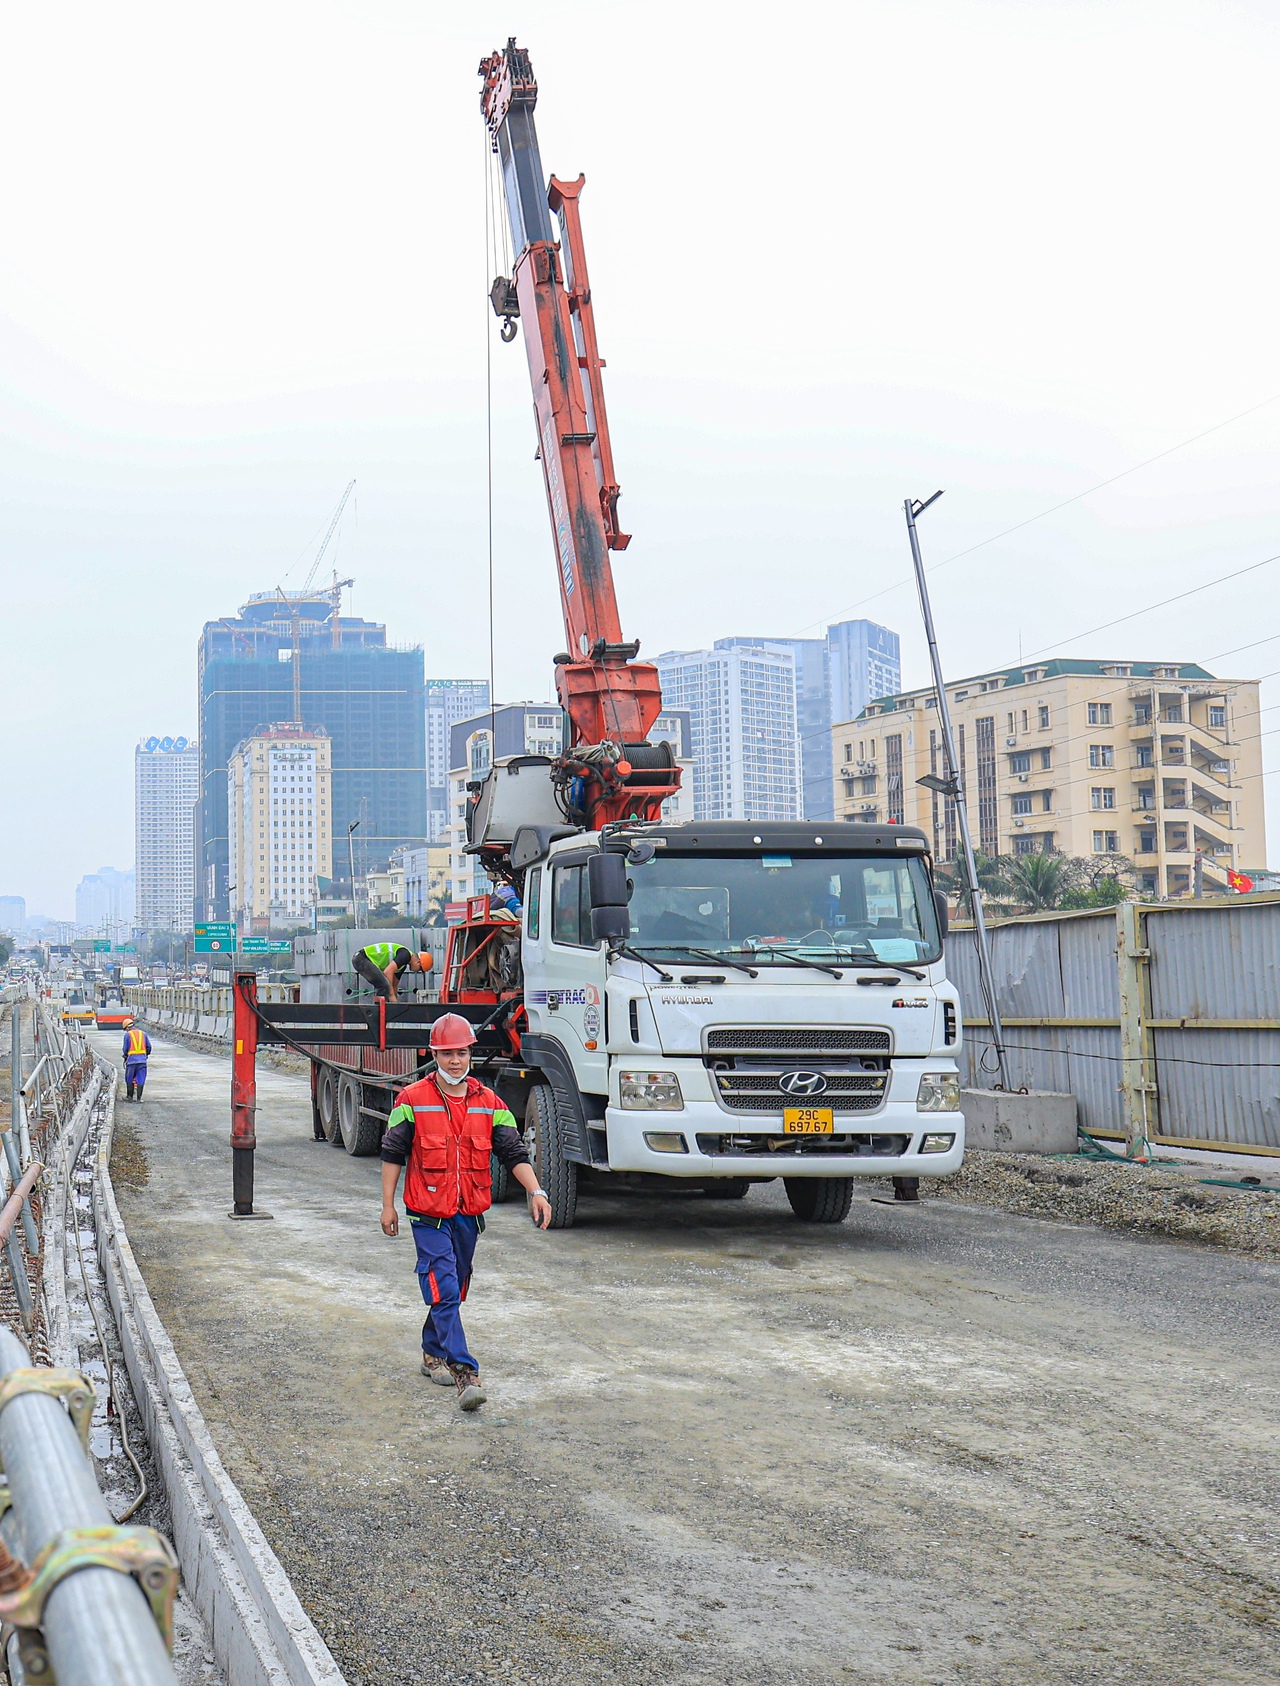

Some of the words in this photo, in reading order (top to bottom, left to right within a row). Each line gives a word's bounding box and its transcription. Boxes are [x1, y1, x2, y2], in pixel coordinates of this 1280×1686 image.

[662, 996, 714, 1005] HYUNDAI
[798, 1110, 819, 1121] 29C
[789, 1122, 828, 1132] 697.67
